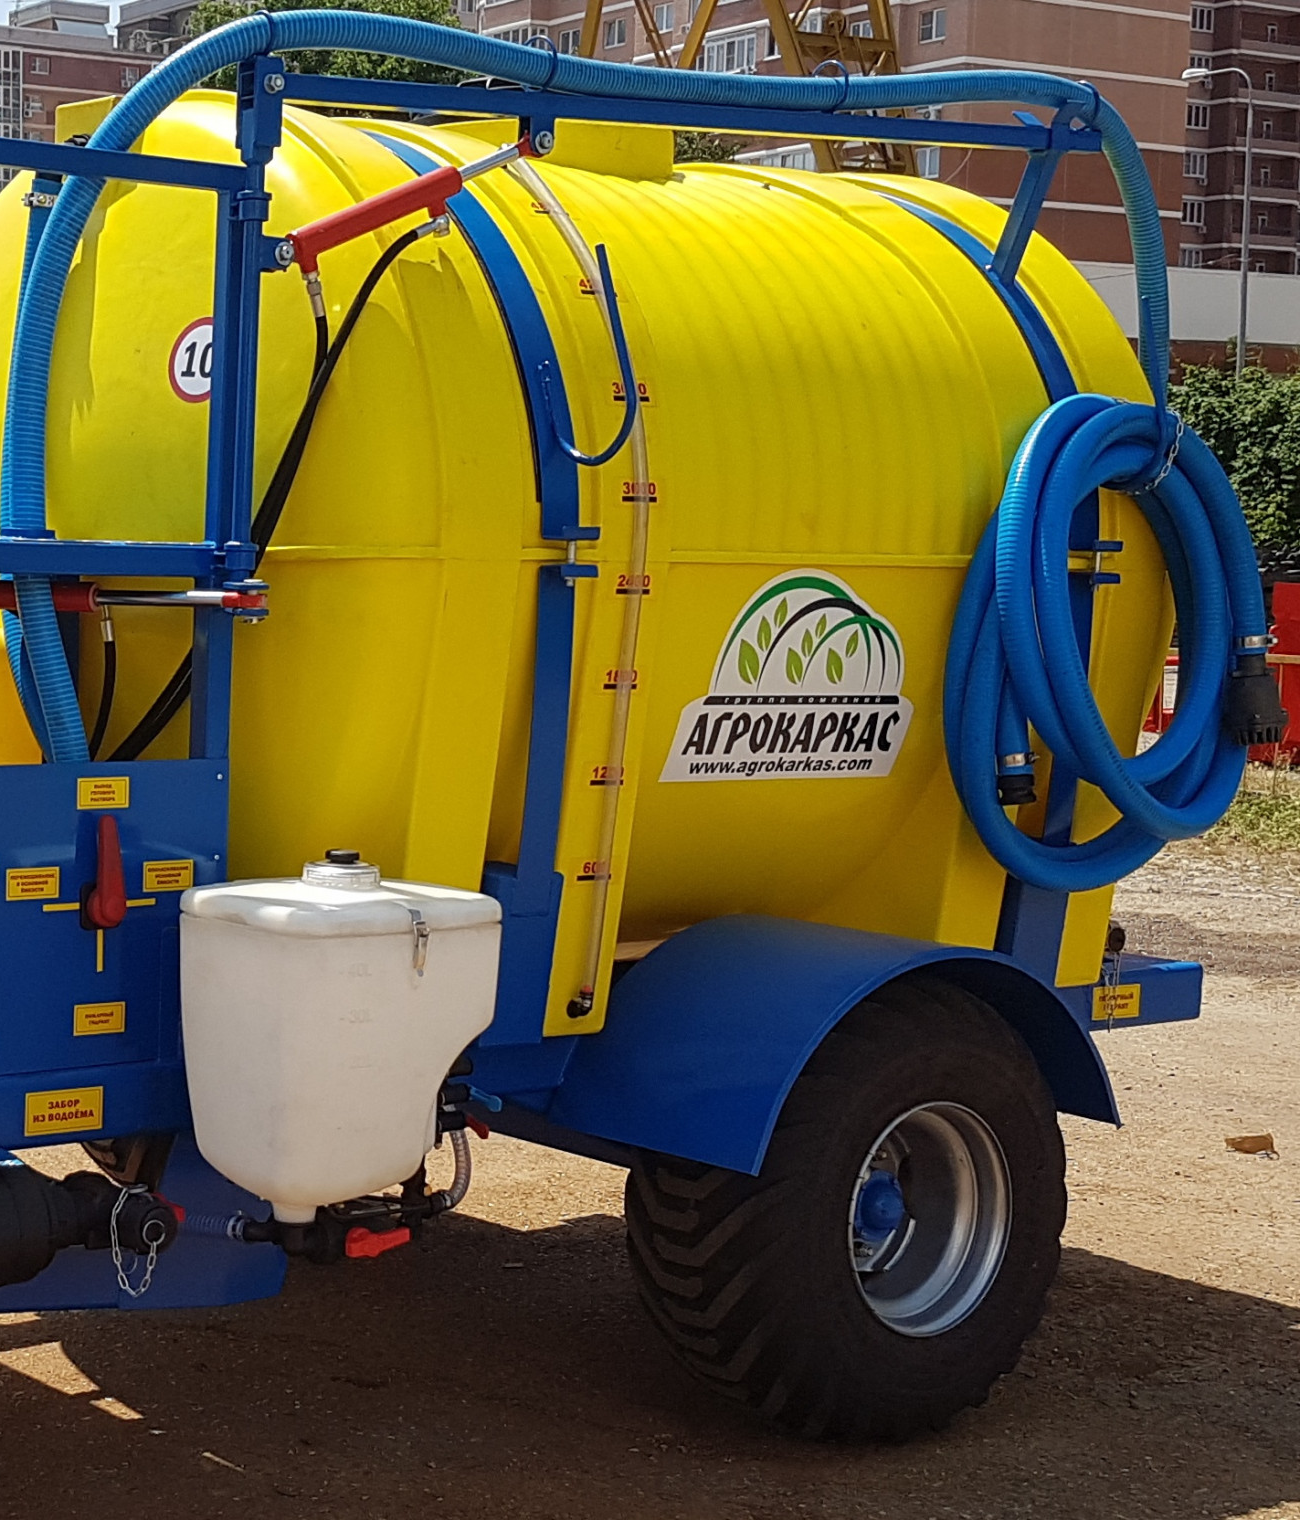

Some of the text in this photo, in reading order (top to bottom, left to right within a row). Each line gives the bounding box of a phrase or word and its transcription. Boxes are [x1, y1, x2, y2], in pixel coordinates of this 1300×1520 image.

[617, 574, 650, 588] 240
[681, 711, 900, 755] АГРОКАРКАС
[689, 756, 873, 776] www.agrokarkas.com
[48, 1099, 80, 1109] ЗАБОР
[33, 1109, 94, 1123] ИЗ ВОДОЁМА
